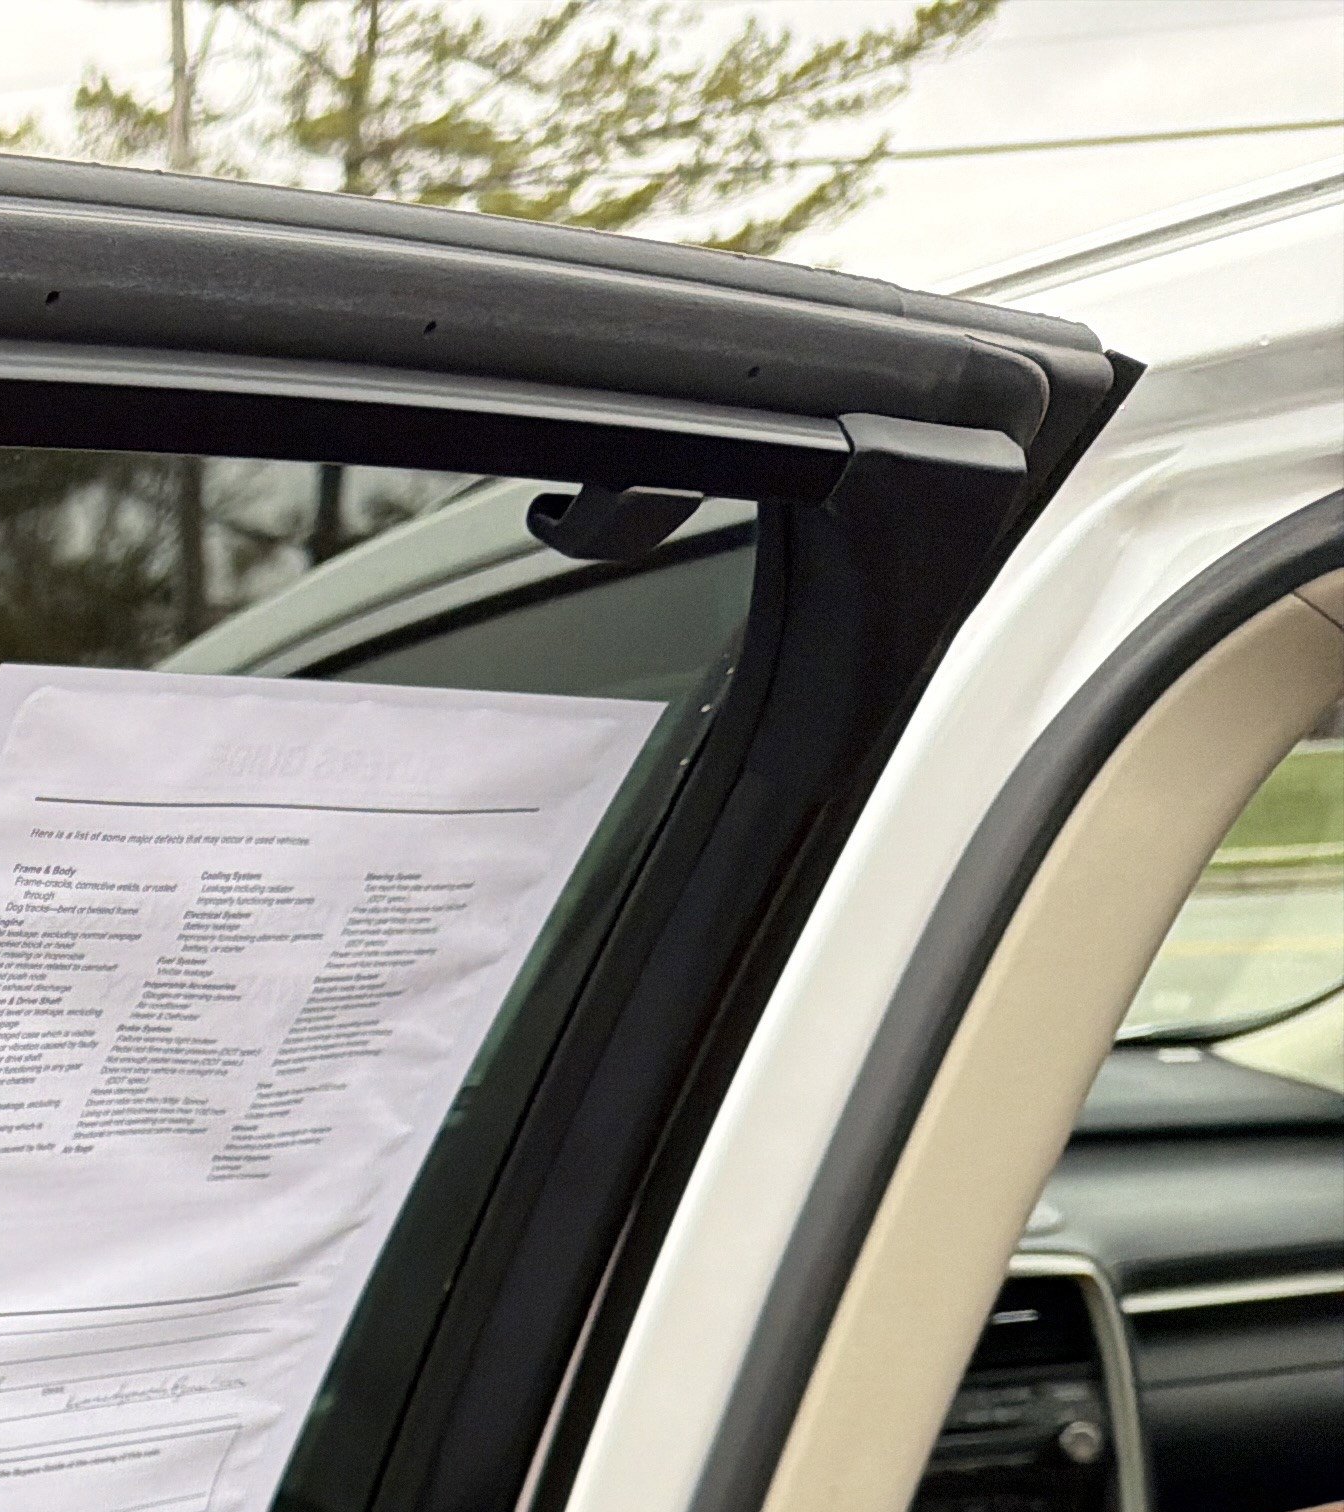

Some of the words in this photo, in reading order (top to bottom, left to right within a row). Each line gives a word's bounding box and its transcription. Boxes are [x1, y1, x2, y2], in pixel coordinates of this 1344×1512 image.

[30, 828, 53, 838] Here
[74, 830, 89, 840] list
[101, 833, 126, 842] some
[127, 834, 152, 843] major
[154, 834, 184, 844] defects
[13, 863, 42, 873] Frame
[52, 865, 76, 875] Body
